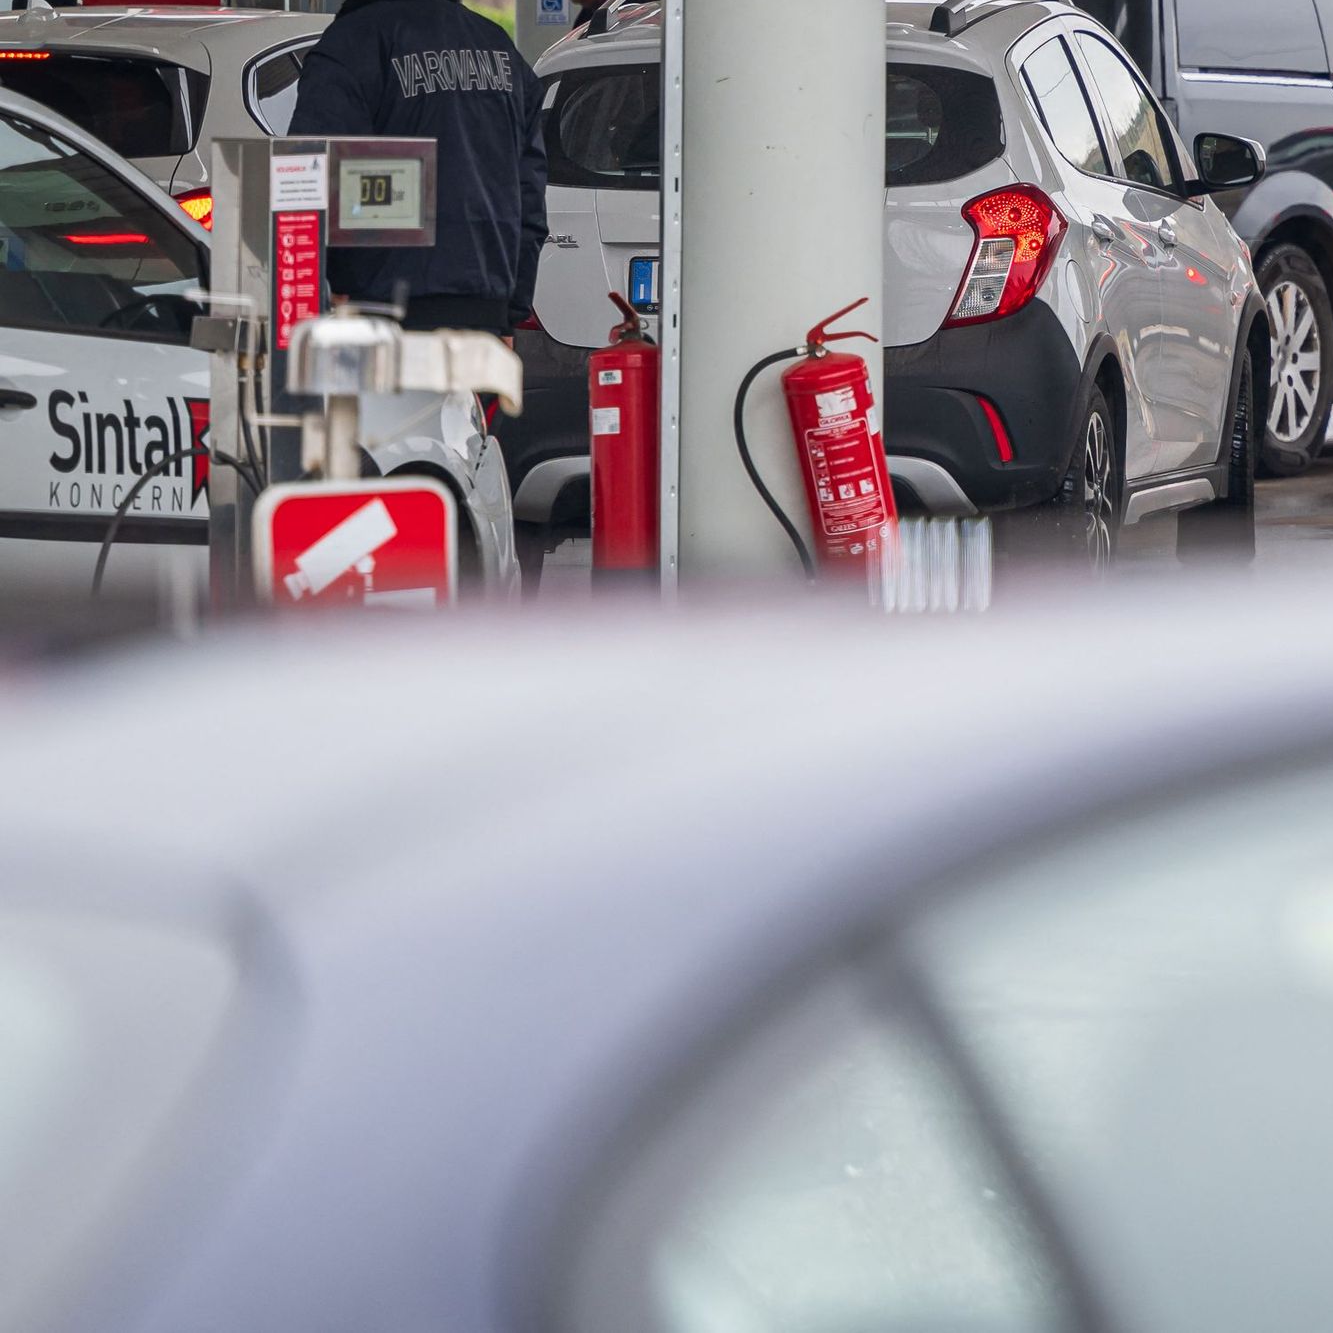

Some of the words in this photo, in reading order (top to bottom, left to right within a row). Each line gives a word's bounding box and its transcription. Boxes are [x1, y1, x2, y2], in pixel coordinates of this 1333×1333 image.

[391, 49, 513, 98] VAROVANJE
[544, 235, 577, 243] ARL
[48, 389, 183, 477] Sintal
[49, 481, 183, 512] KONCERN
